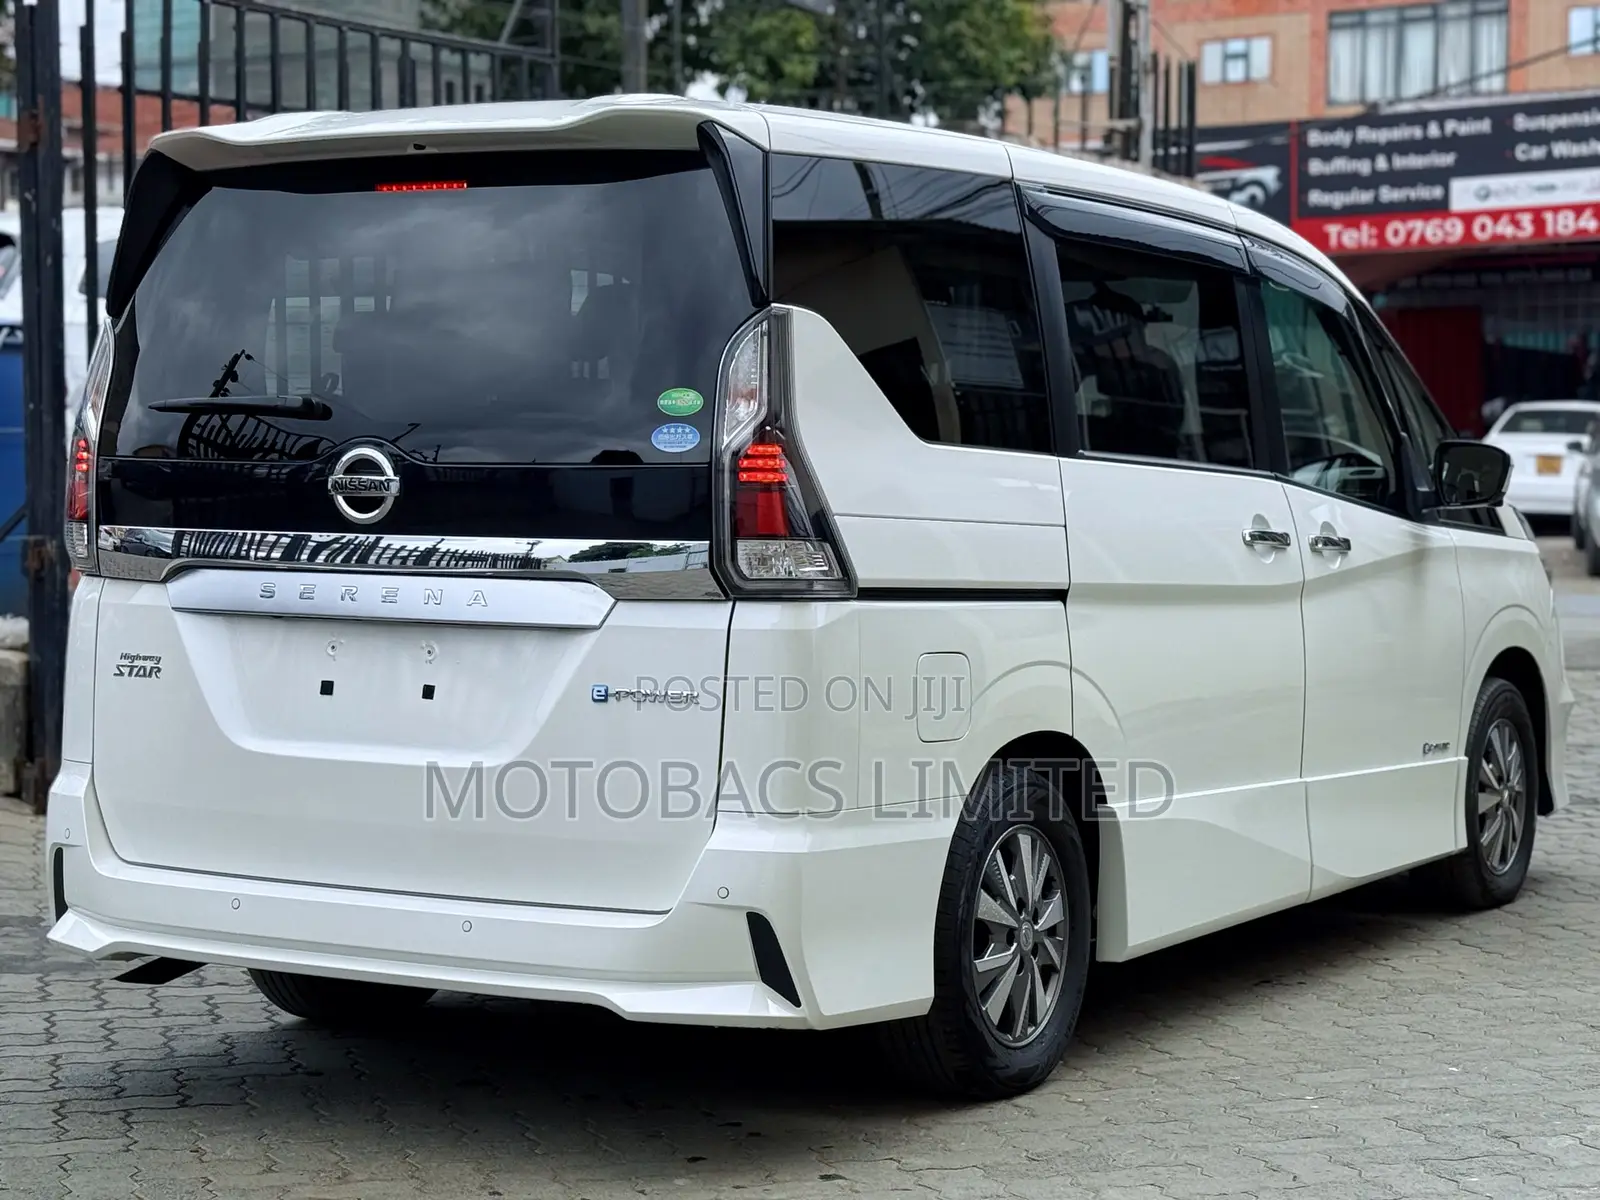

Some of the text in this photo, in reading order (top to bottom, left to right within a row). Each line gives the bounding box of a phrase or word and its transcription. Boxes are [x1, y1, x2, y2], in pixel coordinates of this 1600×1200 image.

[1513, 107, 1600, 132] Suspensi
[1307, 117, 1492, 148] Body Repairs & Paint
[1308, 150, 1459, 176] Buffing & Interior
[1515, 142, 1549, 161] Car
[1308, 187, 1375, 209] Regular
[1378, 182, 1445, 203] Service
[1323, 221, 1379, 249] Tel:
[1385, 216, 1465, 246] 0769
[1472, 212, 1534, 241] 043
[333, 480, 390, 492] NISSAN
[259, 582, 488, 607] SERENA
[120, 652, 162, 665] Highway
[113, 664, 162, 679] STAR
